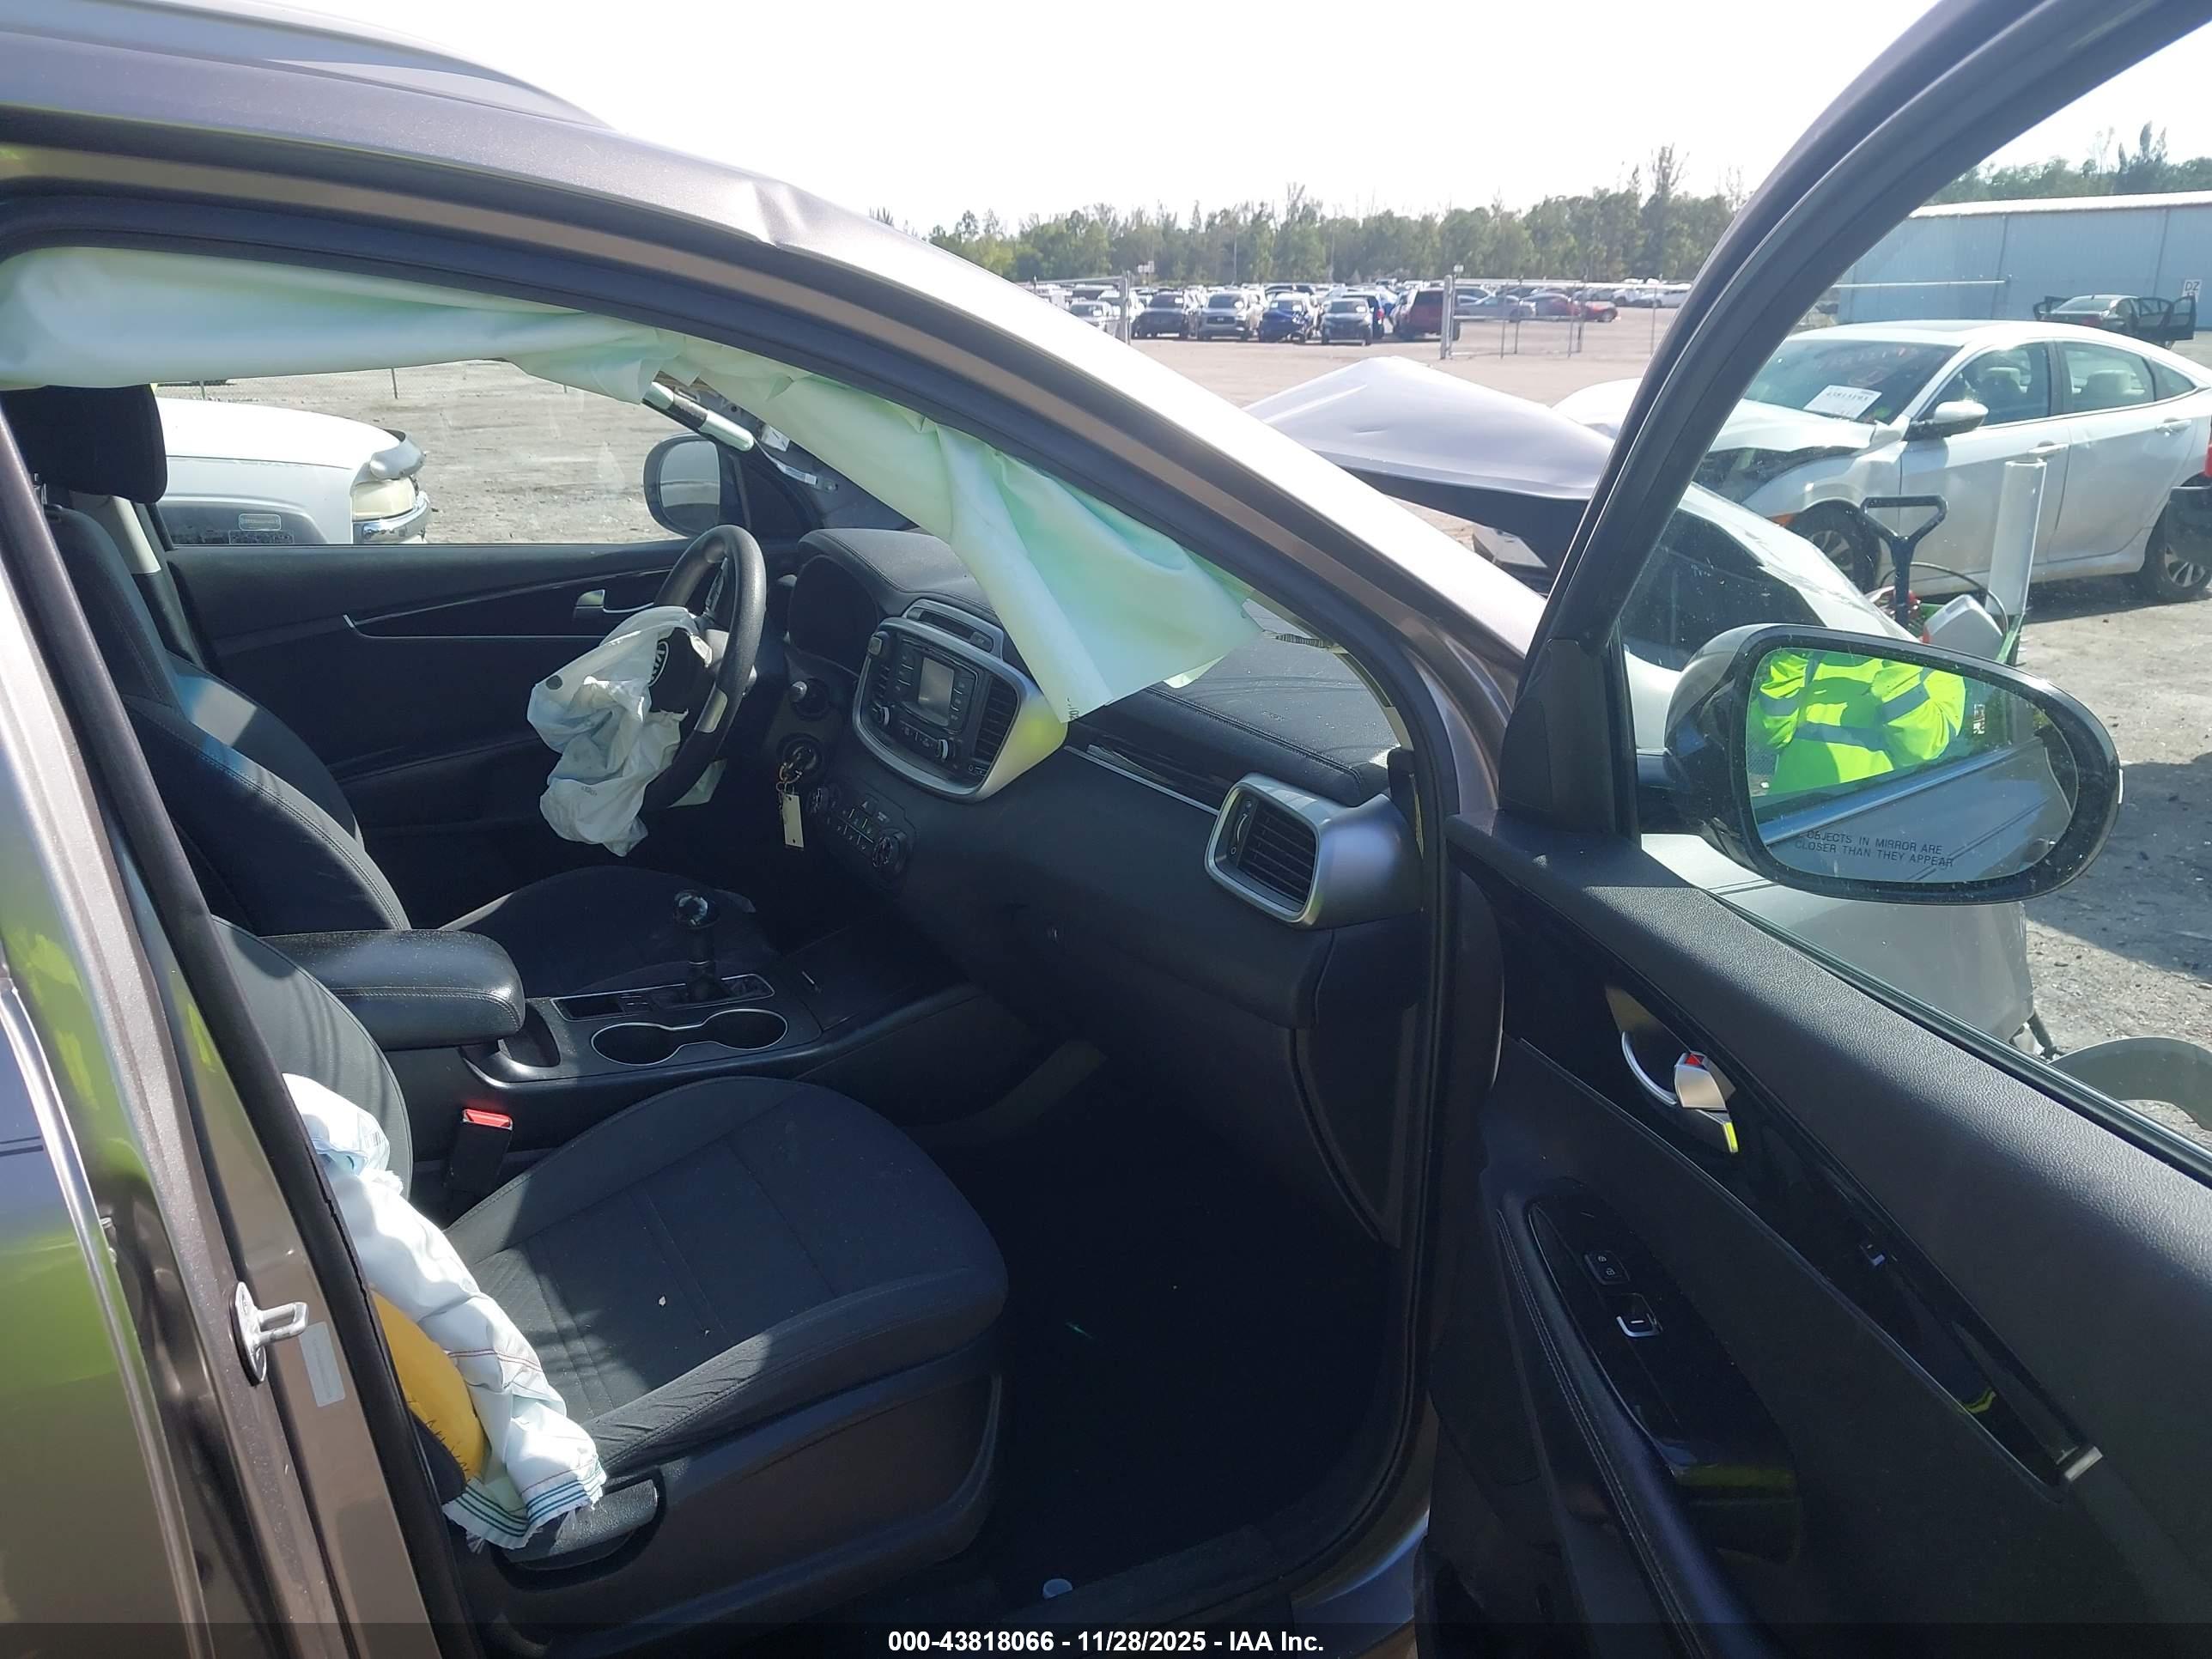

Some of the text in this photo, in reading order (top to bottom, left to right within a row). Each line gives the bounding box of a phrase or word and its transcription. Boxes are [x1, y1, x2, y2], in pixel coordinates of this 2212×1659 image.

[1795, 840, 1955, 868] CLOSER THAN THEY APPEAR
[1806, 830, 1944, 855] OBJECTS IN MIRROR ARE
